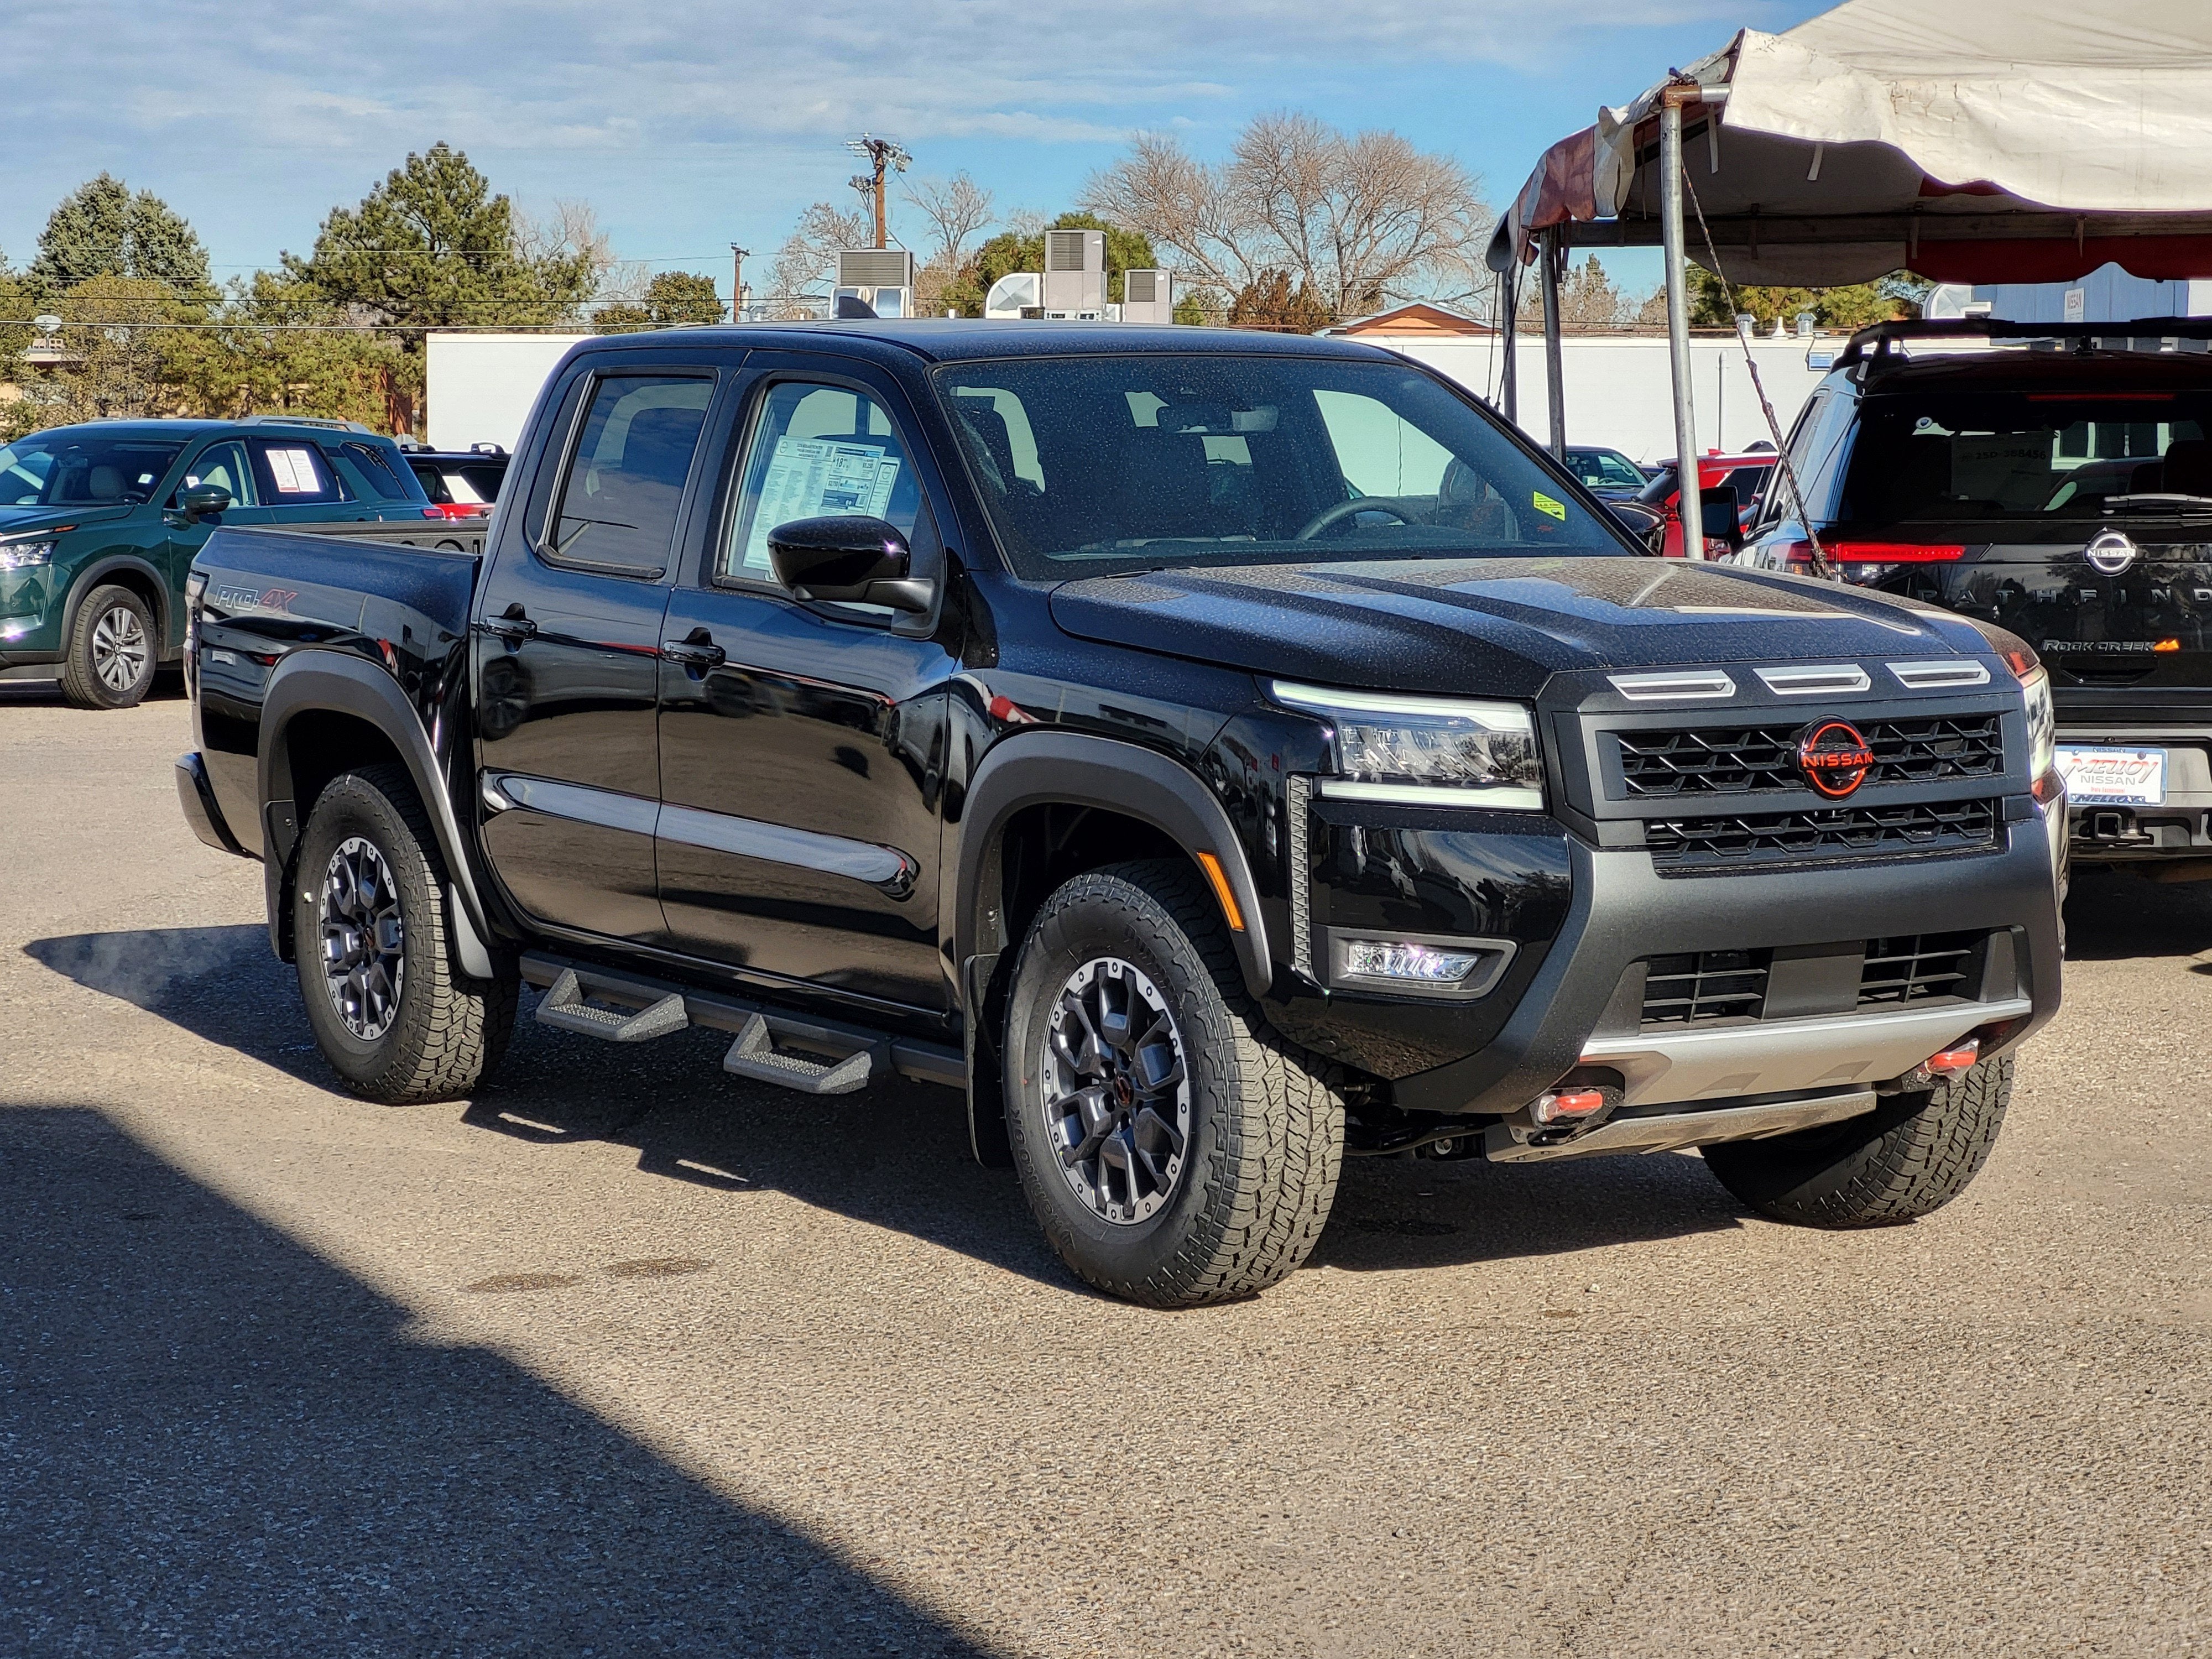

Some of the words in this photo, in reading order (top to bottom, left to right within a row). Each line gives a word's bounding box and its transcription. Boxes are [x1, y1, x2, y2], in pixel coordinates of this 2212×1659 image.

[836, 457, 843, 467] 18
[2087, 549, 2136, 558] NISSAN
[2041, 639, 2095, 652] ROCK
[2096, 640, 2157, 652] CREEK
[1802, 752, 1873, 767] NISSAN
[2062, 758, 2158, 784] MELLOY
[2080, 775, 2135, 785] NISSAN
